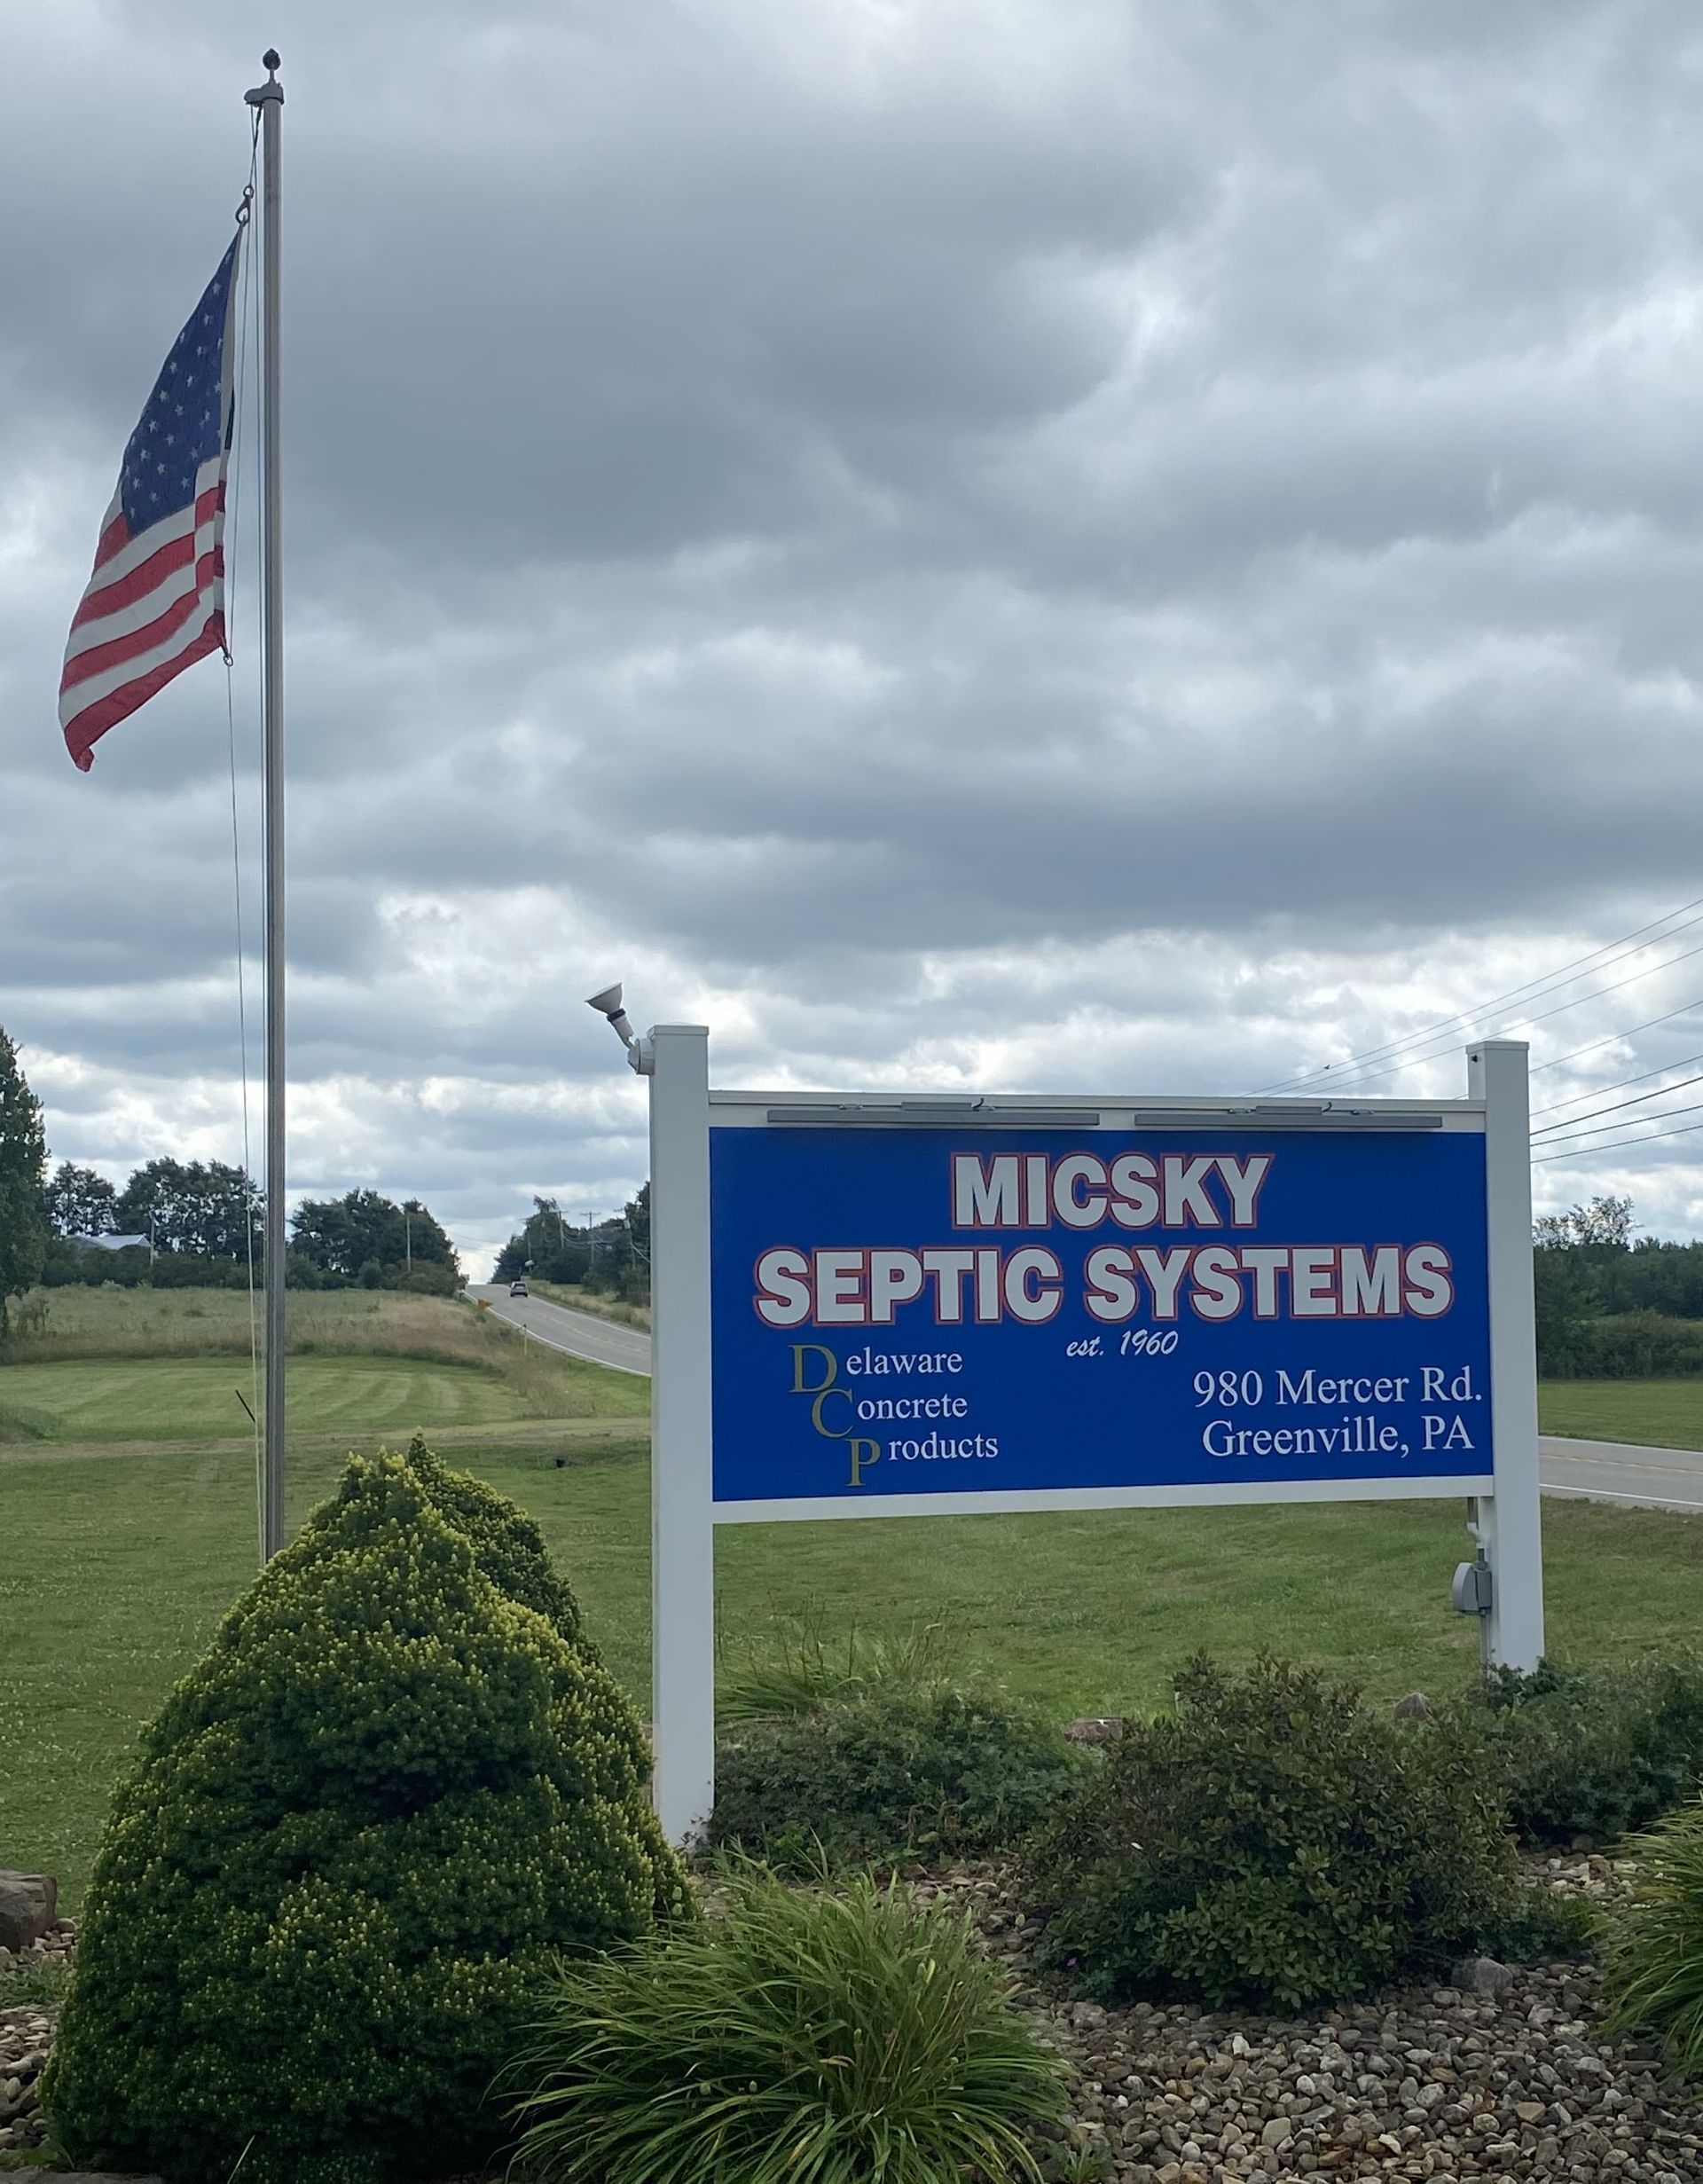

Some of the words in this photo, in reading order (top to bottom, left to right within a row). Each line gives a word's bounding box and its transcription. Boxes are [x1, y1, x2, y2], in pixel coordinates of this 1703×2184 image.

[951, 1151, 1274, 1230] MICSKY
[753, 1245, 1064, 1328] SEPTIC
[1084, 1242, 1455, 1323] SYSTEMS
[1066, 1337, 1104, 1357] est.
[1119, 1328, 1179, 1355] 1960
[789, 1344, 963, 1394] Delaware
[1194, 1371, 1263, 1408] 980
[1276, 1370, 1410, 1405] Mercer
[1420, 1365, 1482, 1402] Rd.
[811, 1387, 969, 1439] Concrete
[1203, 1416, 1409, 1458] Greenville,
[1422, 1415, 1475, 1450] PA
[844, 1432, 1000, 1486] Products
